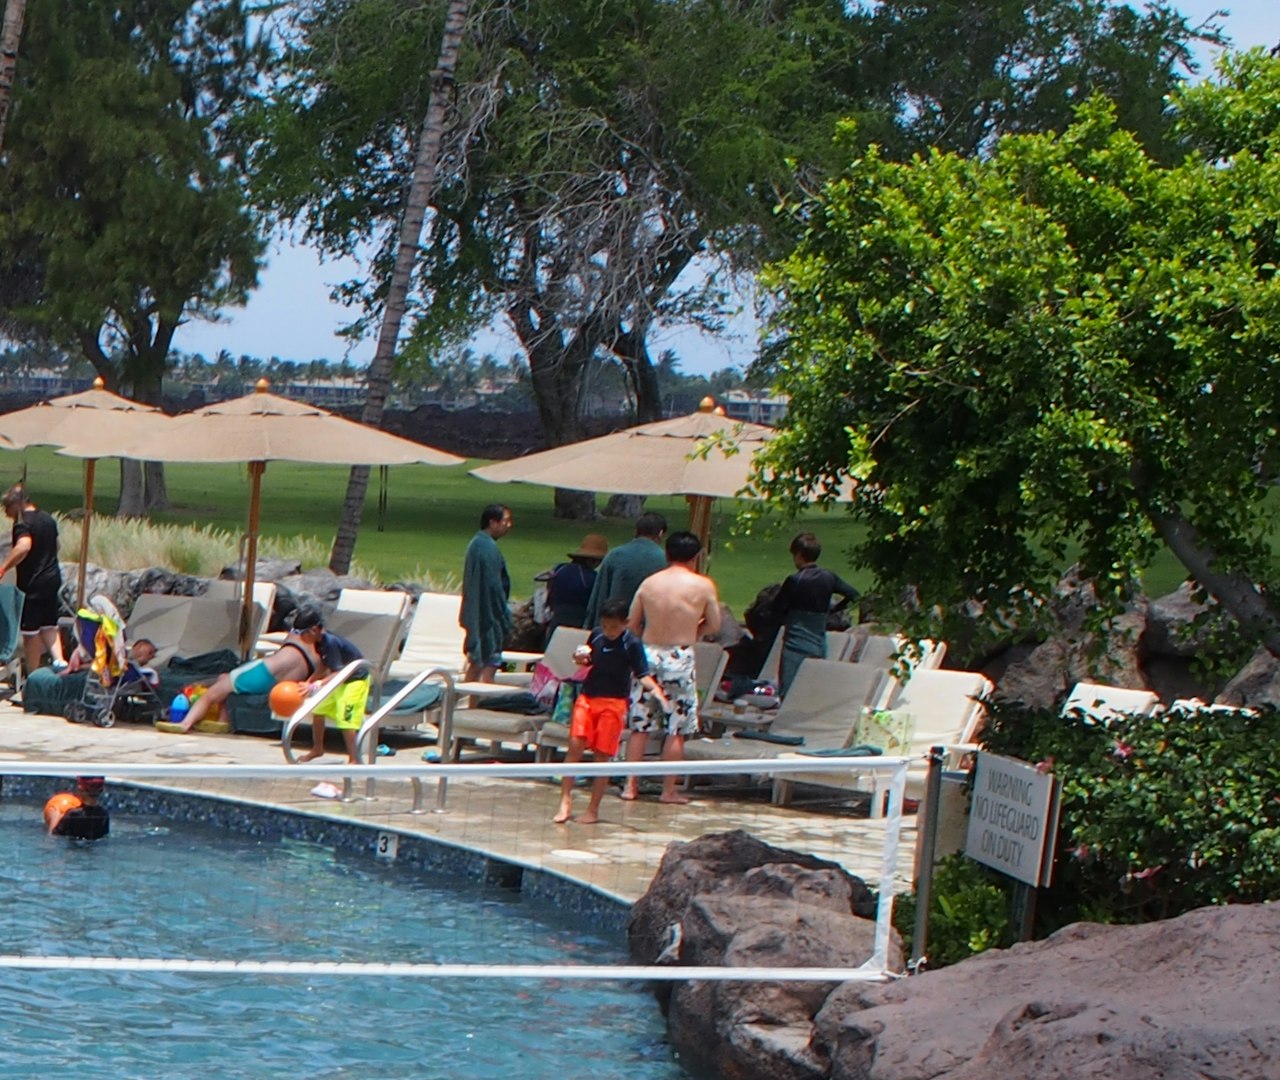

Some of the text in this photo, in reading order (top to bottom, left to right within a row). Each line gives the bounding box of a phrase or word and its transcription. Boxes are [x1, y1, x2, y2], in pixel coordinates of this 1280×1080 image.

[988, 769, 1033, 806] WARNING
[973, 795, 1040, 841] NO LIFEGUARD
[379, 835, 388, 853] 3
[981, 829, 1025, 867] ON DUTY
